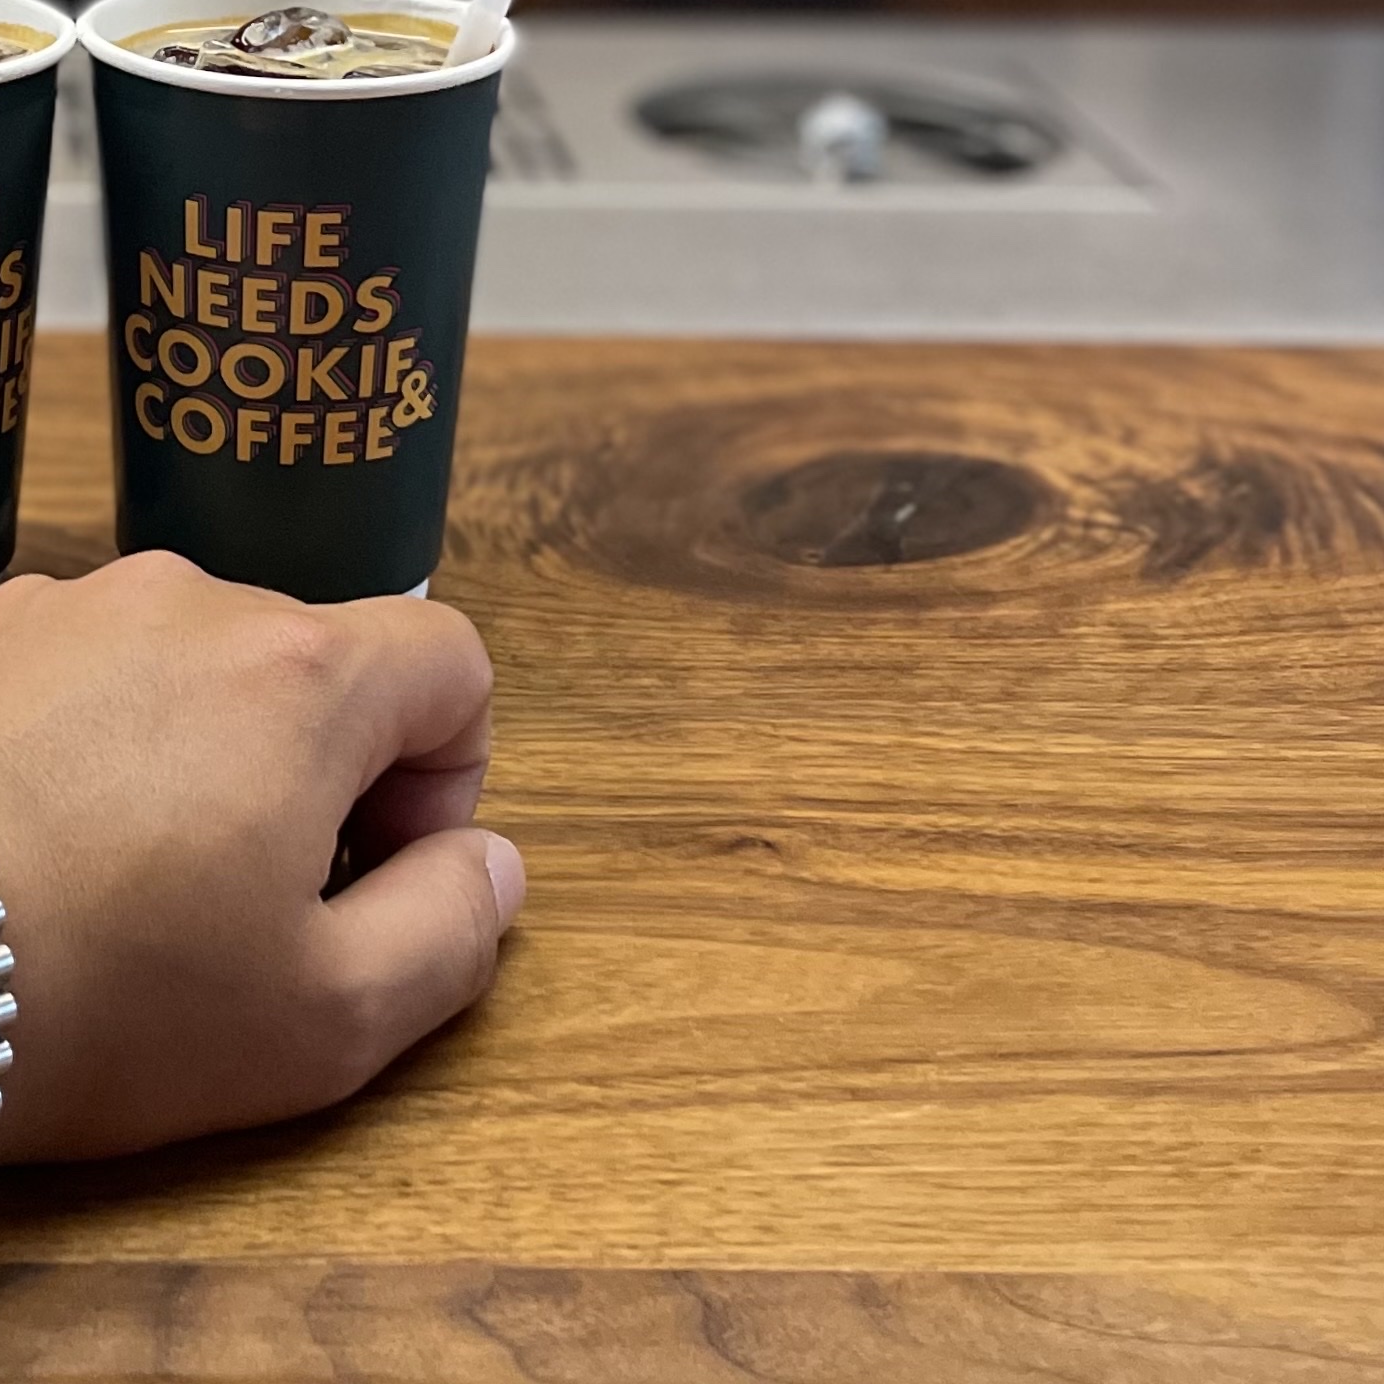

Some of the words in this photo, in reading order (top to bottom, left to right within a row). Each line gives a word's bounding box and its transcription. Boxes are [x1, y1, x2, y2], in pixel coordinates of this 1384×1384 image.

[184, 195, 347, 268] LIFE
[138, 250, 397, 336] NEEDS
[134, 381, 394, 466] COFFEE
[391, 368, 434, 429] &
